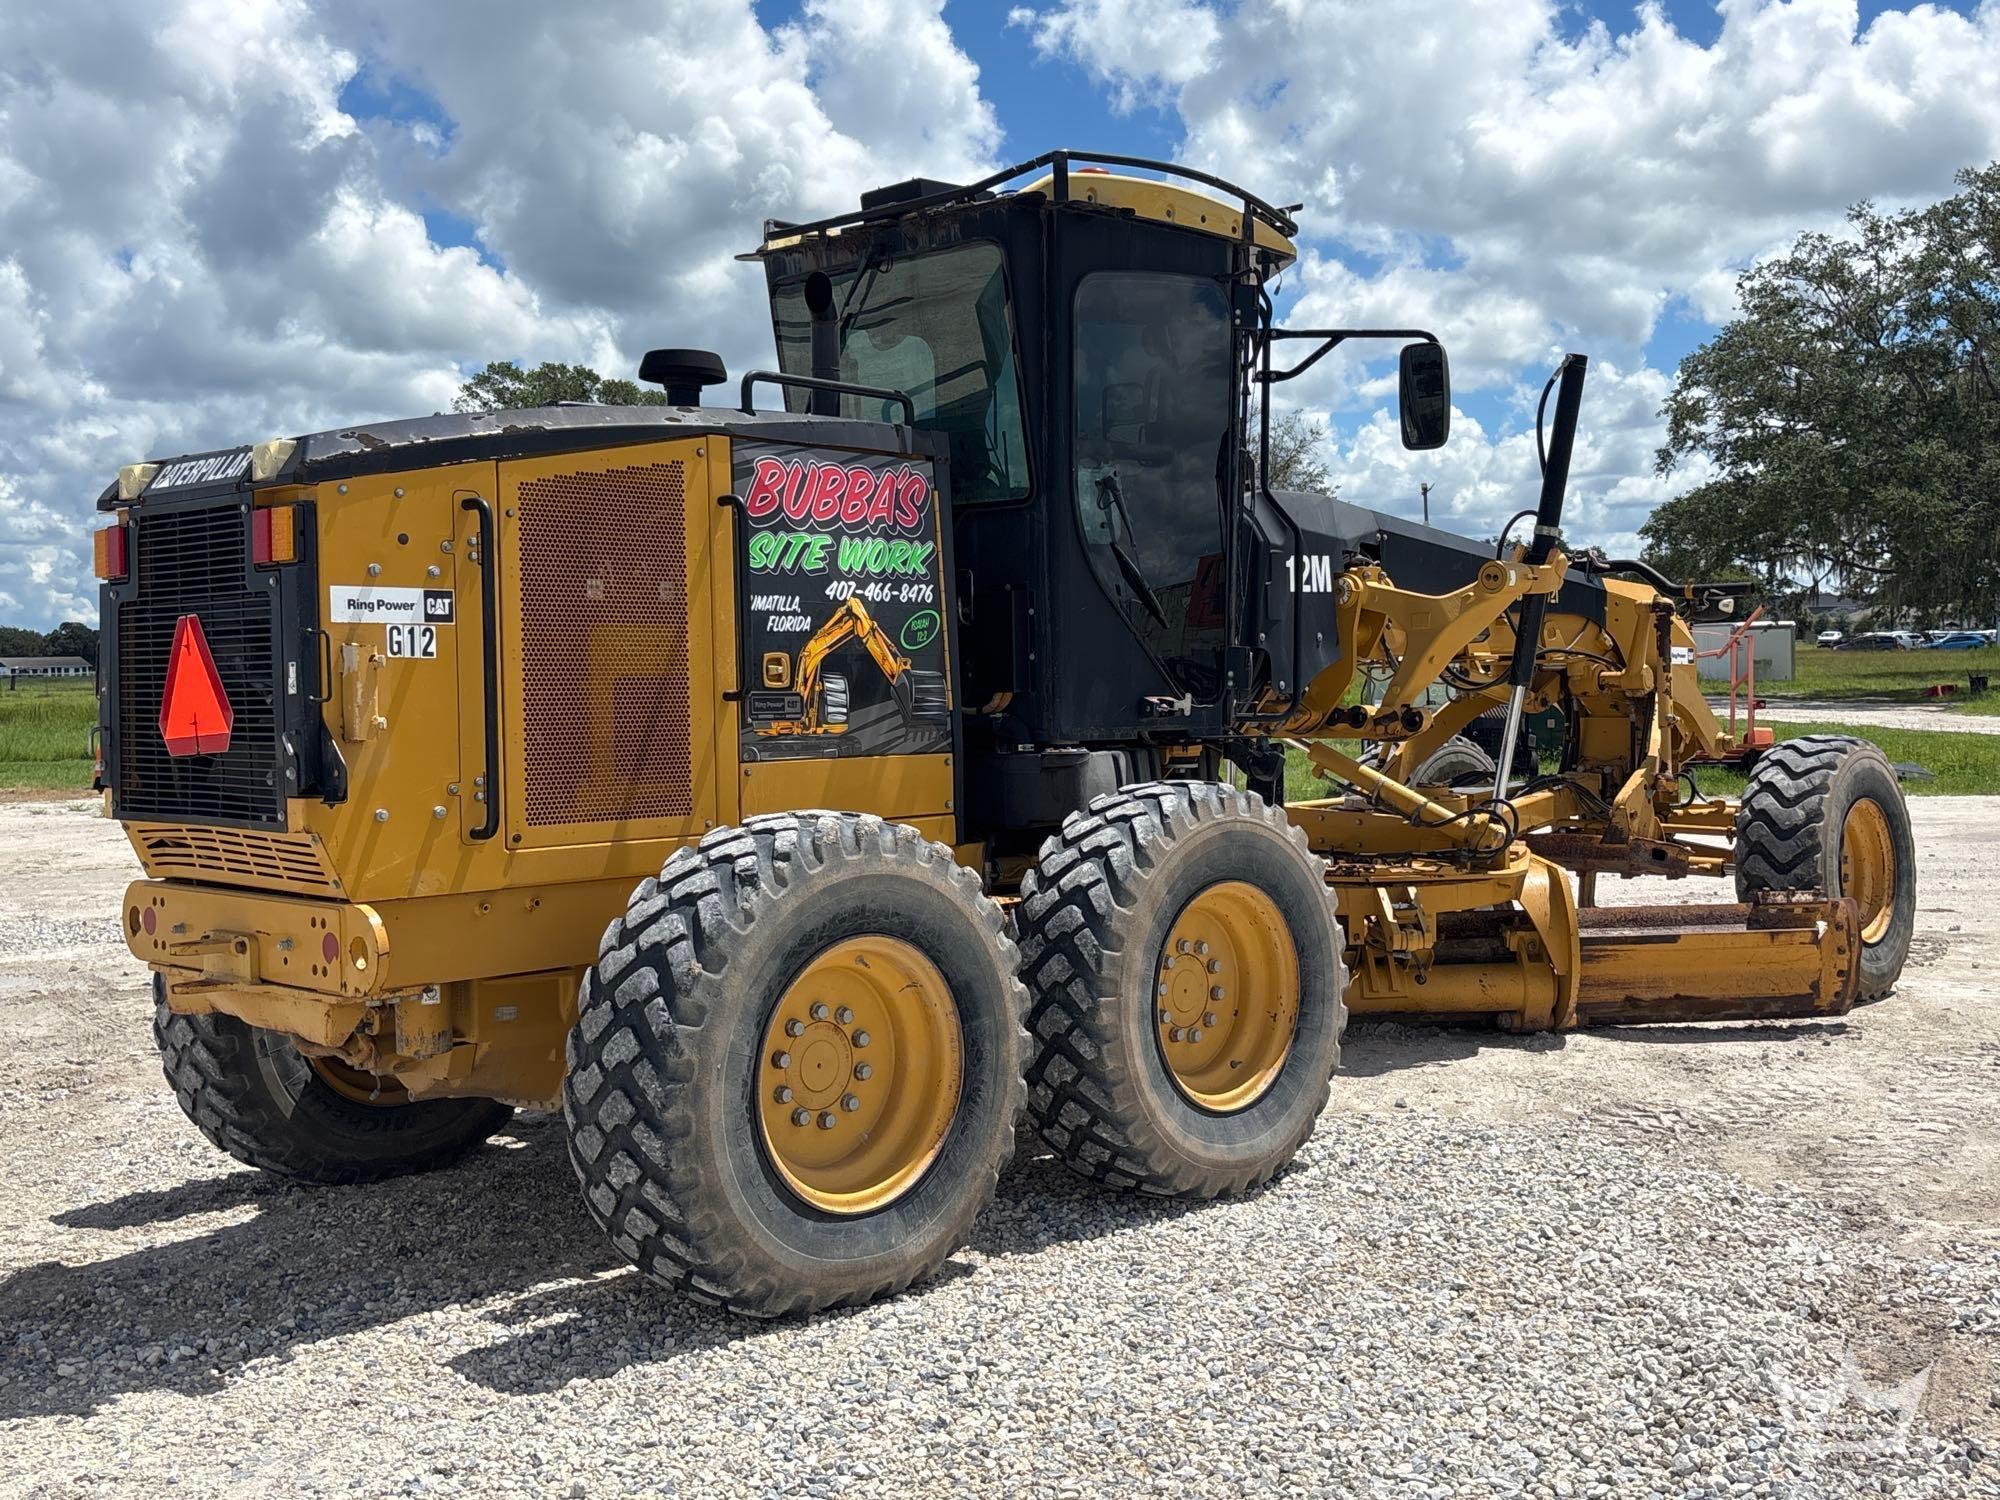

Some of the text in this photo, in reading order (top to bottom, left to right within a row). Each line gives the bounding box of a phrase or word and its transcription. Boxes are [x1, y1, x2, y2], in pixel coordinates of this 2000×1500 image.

[150, 451, 253, 489] CATERPILLAR
[747, 456, 931, 535] BUBBA'S
[749, 530, 937, 579] SITE WORK
[1285, 554, 1333, 593] 12M
[347, 597, 452, 616] Ring Power CAT
[824, 580, 935, 604] 407-466-8476
[388, 625, 436, 658] G12
[766, 615, 812, 633] FLORIDA
